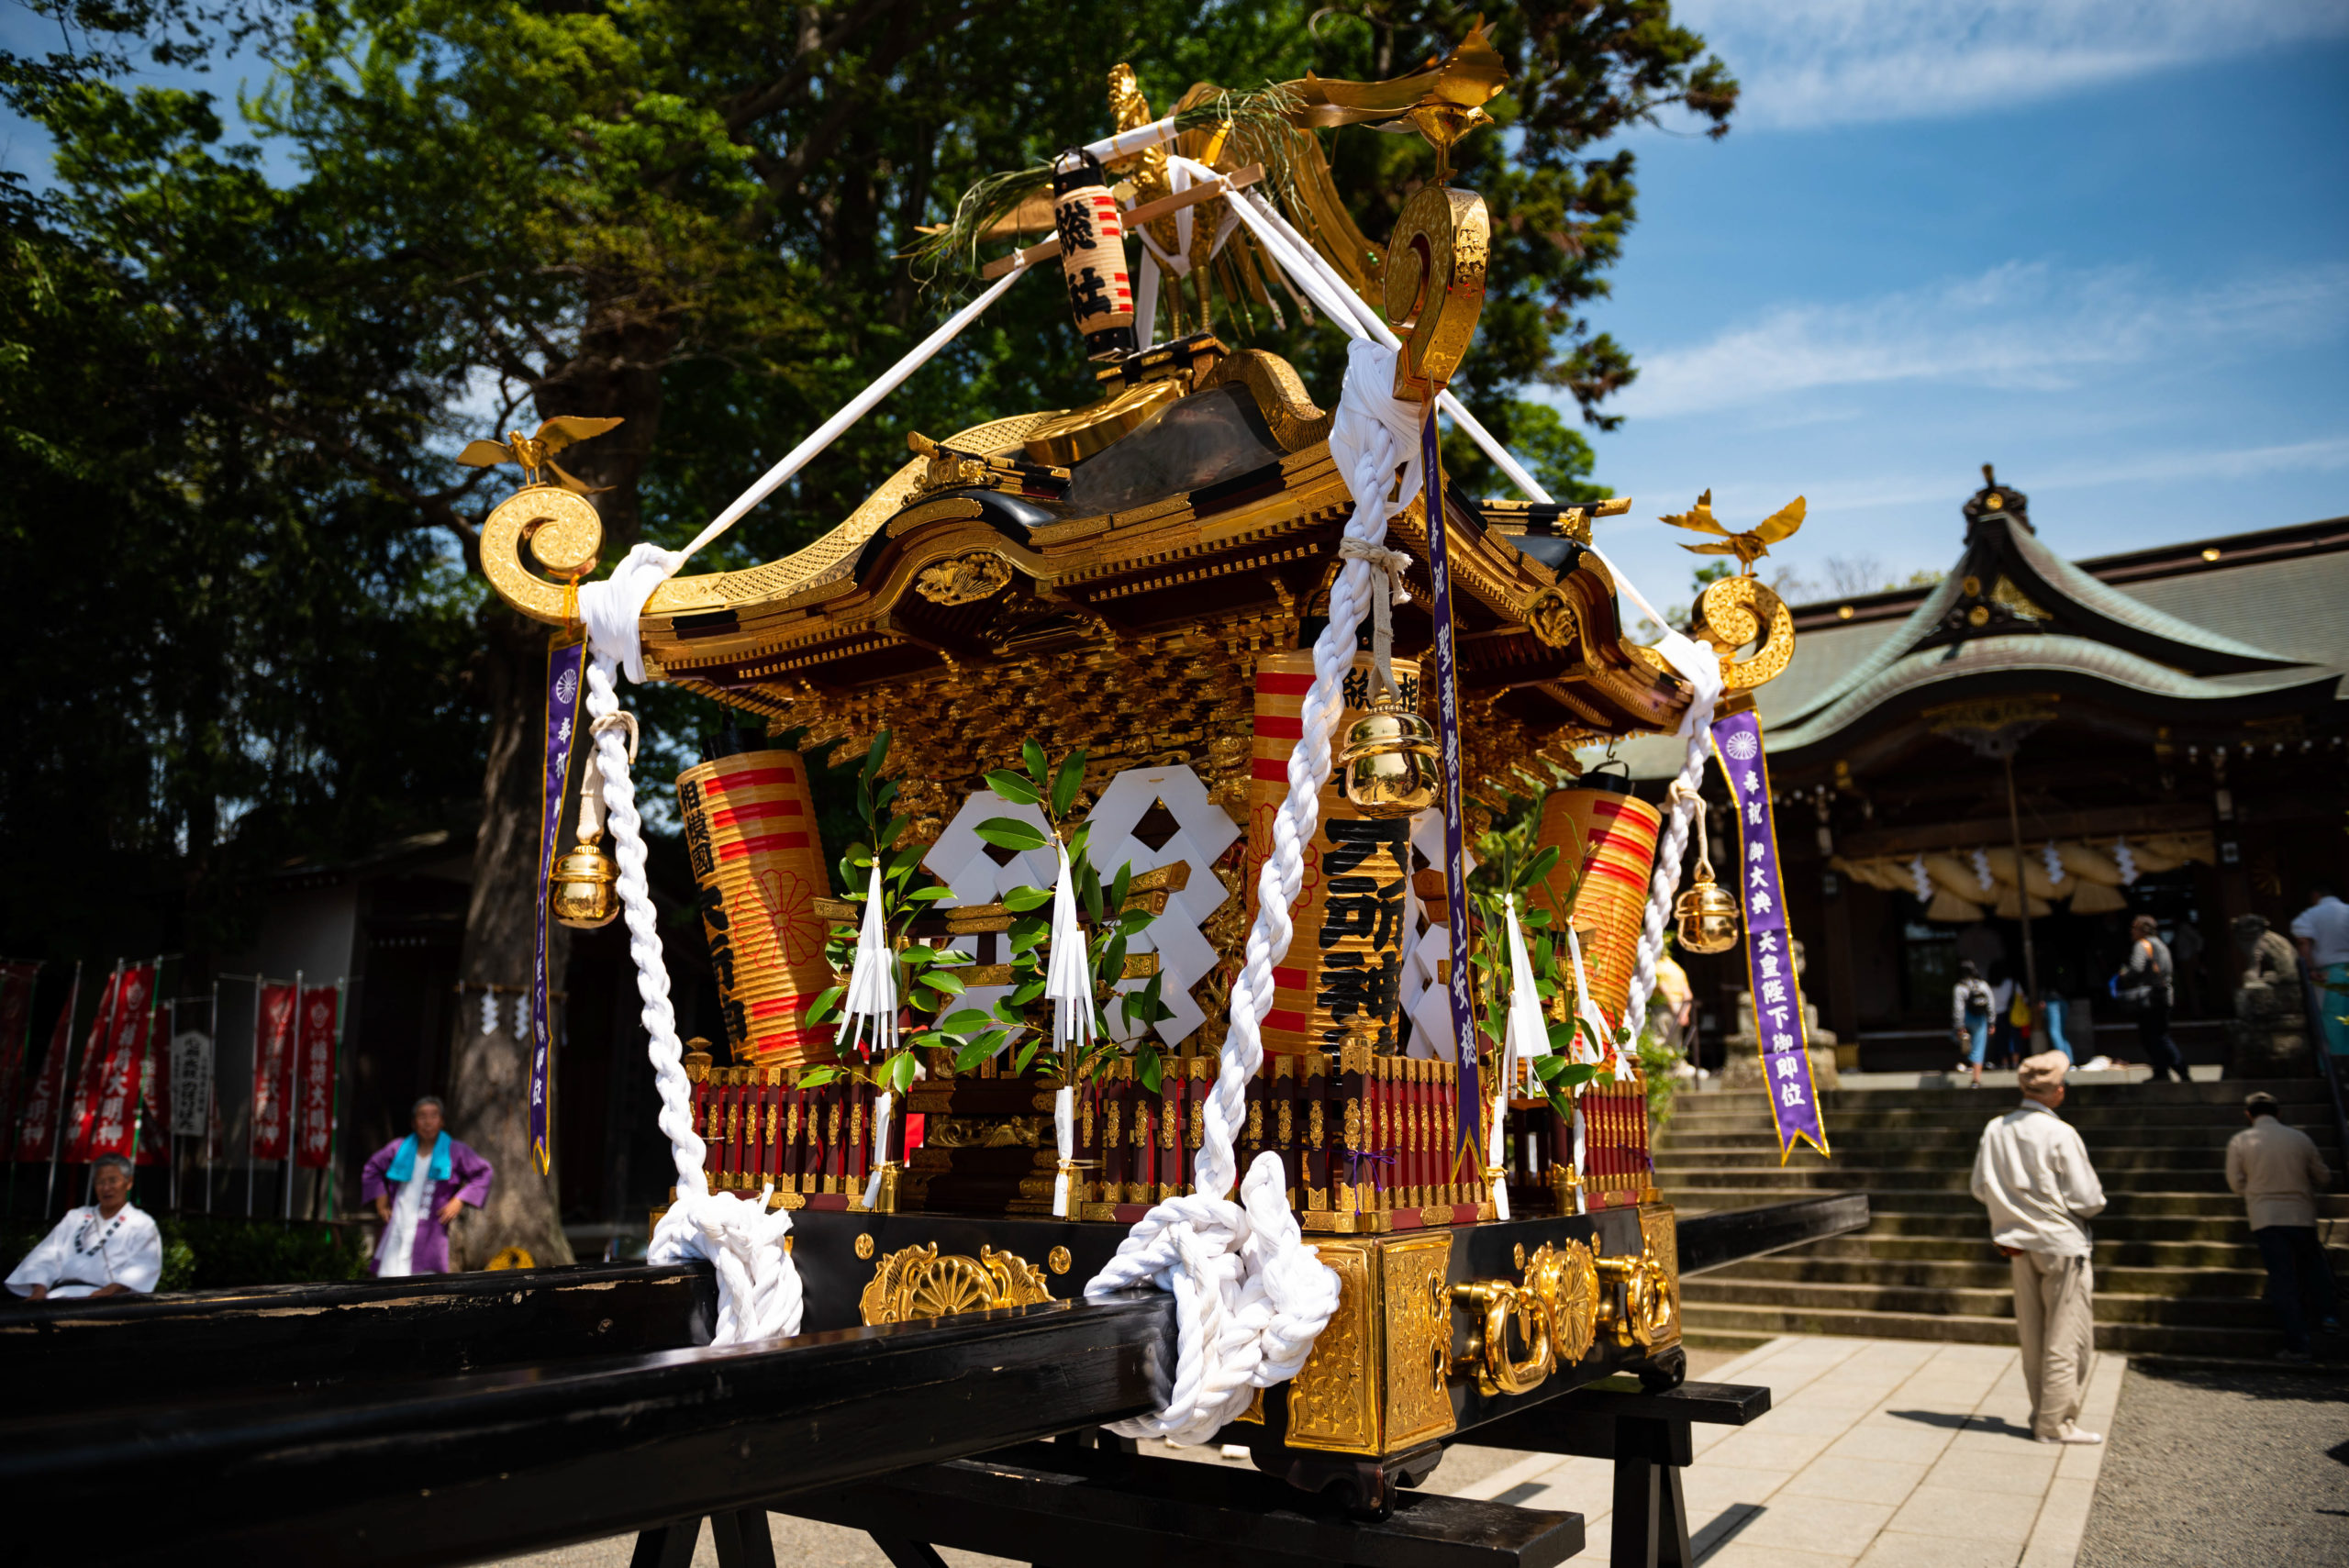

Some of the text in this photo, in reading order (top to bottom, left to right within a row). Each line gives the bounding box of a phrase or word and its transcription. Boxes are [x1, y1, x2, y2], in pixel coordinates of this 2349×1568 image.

[1743, 770, 1806, 1108] 奉祝 御大典 天皇陛下御即位
